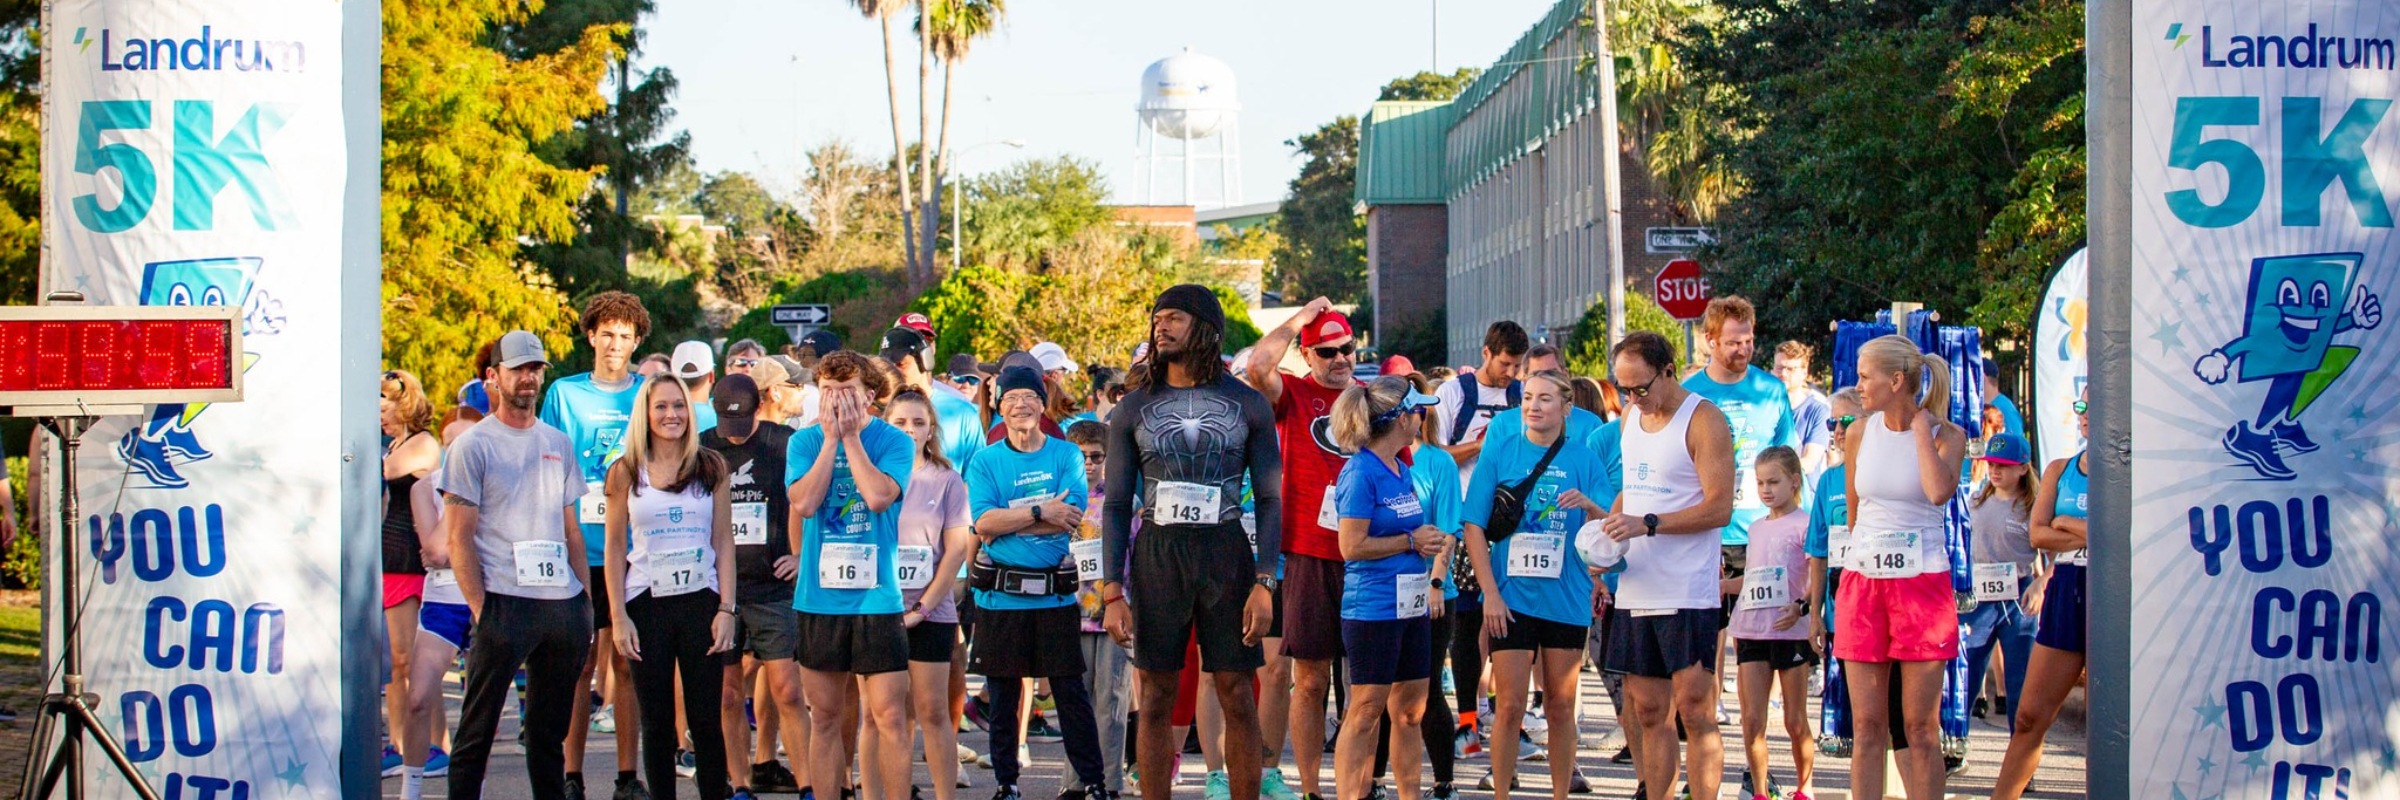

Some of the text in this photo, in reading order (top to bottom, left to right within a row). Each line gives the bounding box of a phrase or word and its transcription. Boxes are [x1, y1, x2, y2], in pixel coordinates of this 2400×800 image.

[101, 25, 305, 72] Landrum
[2202, 23, 2394, 70] Landrum
[72, 99, 303, 233] 5K
[2164, 97, 2394, 228] 5K
[1172, 503, 1200, 521] 143
[643, 528, 664, 537] CLARK
[2188, 495, 2332, 576] YOU
[89, 503, 226, 584] YOU
[538, 562, 554, 577] 18
[1081, 559, 1097, 573] 85
[1523, 553, 1549, 568] 115
[1873, 553, 1904, 569] 148
[672, 570, 690, 585] 17
[838, 565, 856, 580] 16
[1750, 586, 1772, 600] 101
[1982, 581, 2004, 594] 153
[1413, 593, 1426, 608] 26
[2251, 587, 2381, 663] CAN
[143, 595, 285, 674] CAN
[2226, 673, 2323, 752] DO
[121, 684, 217, 762] DO
